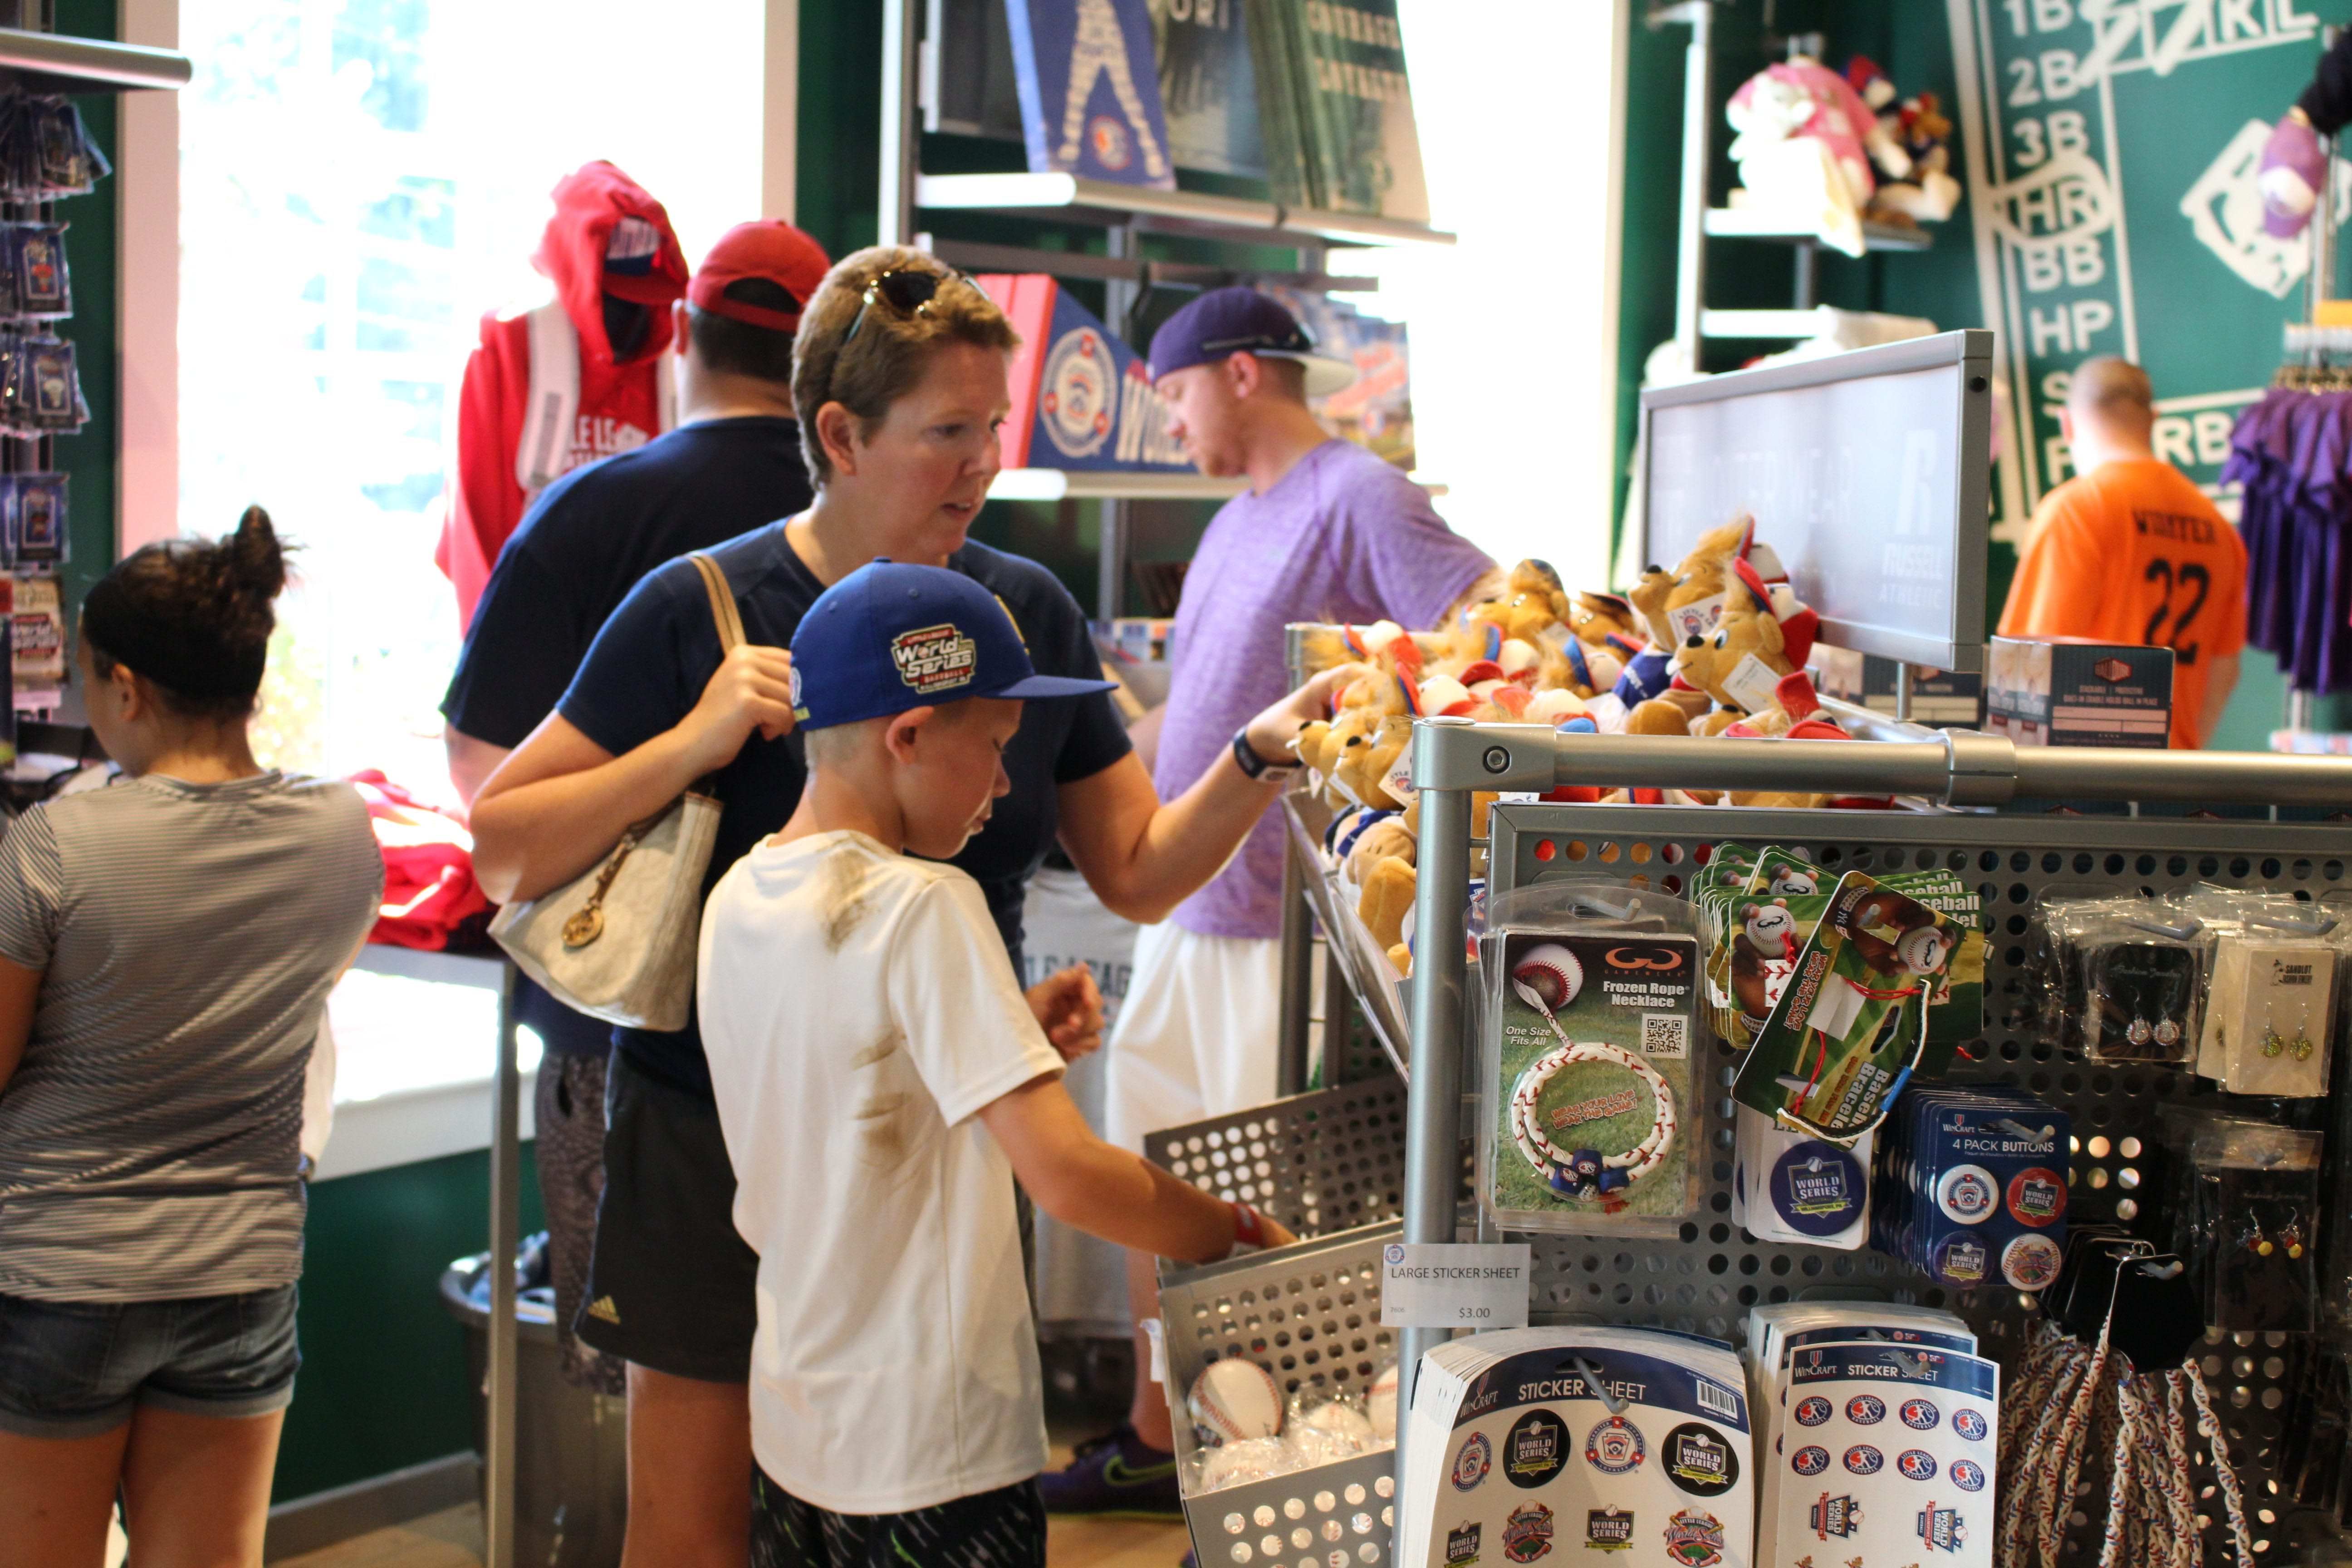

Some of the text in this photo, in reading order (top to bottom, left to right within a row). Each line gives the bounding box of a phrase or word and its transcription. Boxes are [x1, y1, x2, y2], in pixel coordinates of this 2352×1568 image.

[2008, 49, 2081, 108] 2B
[2013, 111, 2089, 167] 3B
[2016, 182, 2102, 234] HR
[2023, 236, 2104, 293] BB
[2029, 300, 2113, 358] HP
[1882, 543, 1945, 580] RUSSELL
[1878, 583, 1942, 609] ATHLETIC
[897, 637, 959, 663] World
[906, 650, 972, 679] Series
[1603, 980, 1685, 996] Frozen Rope
[1612, 994, 1676, 1008] Necklace
[1506, 1026, 1552, 1037] One Size
[1510, 1036, 1547, 1046] Fits All
[1830, 1061, 1877, 1129] Bracele
[1551, 1089, 1635, 1119] WEAR YOUR LOVE
[1553, 1098, 1637, 1130] WEAR THE GAME!
[1952, 1139, 2055, 1152] 4 PACK BUTTONS
[1795, 1176, 1840, 1190] WORLD
[1799, 1186, 1839, 1200] SERIES
[2025, 1190, 2053, 1200] WORLD
[2025, 1197, 2050, 1207] SERIES
[1951, 1254, 1980, 1264] WORLD
[1951, 1260, 1977, 1270] SERIES
[1391, 1268, 1520, 1279] LARGE STICKER SHEET
[1459, 1308, 1490, 1319] $3.00
[1847, 1364, 1898, 1377] STICKER
[1518, 1379, 1585, 1401] STICKER
[1799, 1398, 1812, 1409] LITTLE
[1849, 1396, 1864, 1406] LITTLE
[1903, 1401, 1918, 1409] LITTLE
[1800, 1417, 1827, 1426] BASEBALL
[1906, 1420, 1934, 1430] BASEBALL
[1958, 1428, 1983, 1441] BASEBALL
[1519, 1439, 1552, 1450] WORLD
[1847, 1446, 1862, 1455] LITTLE
[1519, 1447, 1549, 1460] SERIES
[1682, 1447, 1721, 1463] WORLD
[1795, 1447, 1808, 1458] LITTLE
[1901, 1450, 1916, 1459] LITTLE
[1683, 1455, 1718, 1471] SERIES
[1953, 1460, 1967, 1468] LITTLE
[1797, 1466, 1824, 1475] BASEBALL
[1849, 1466, 1878, 1474] BASEBALL
[1903, 1470, 1932, 1480] BASEBALL
[1955, 1479, 1980, 1491] BASEBALL
[1827, 1502, 1835, 1531] SERIES
[1833, 1499, 1843, 1534] WORLD
[1591, 1521, 1630, 1530] WORLD
[1940, 1511, 1949, 1547] WORLD
[1592, 1529, 1627, 1539] SERIES
[1450, 1535, 1477, 1549] WORLD
[1450, 1544, 1475, 1559] SERIES
